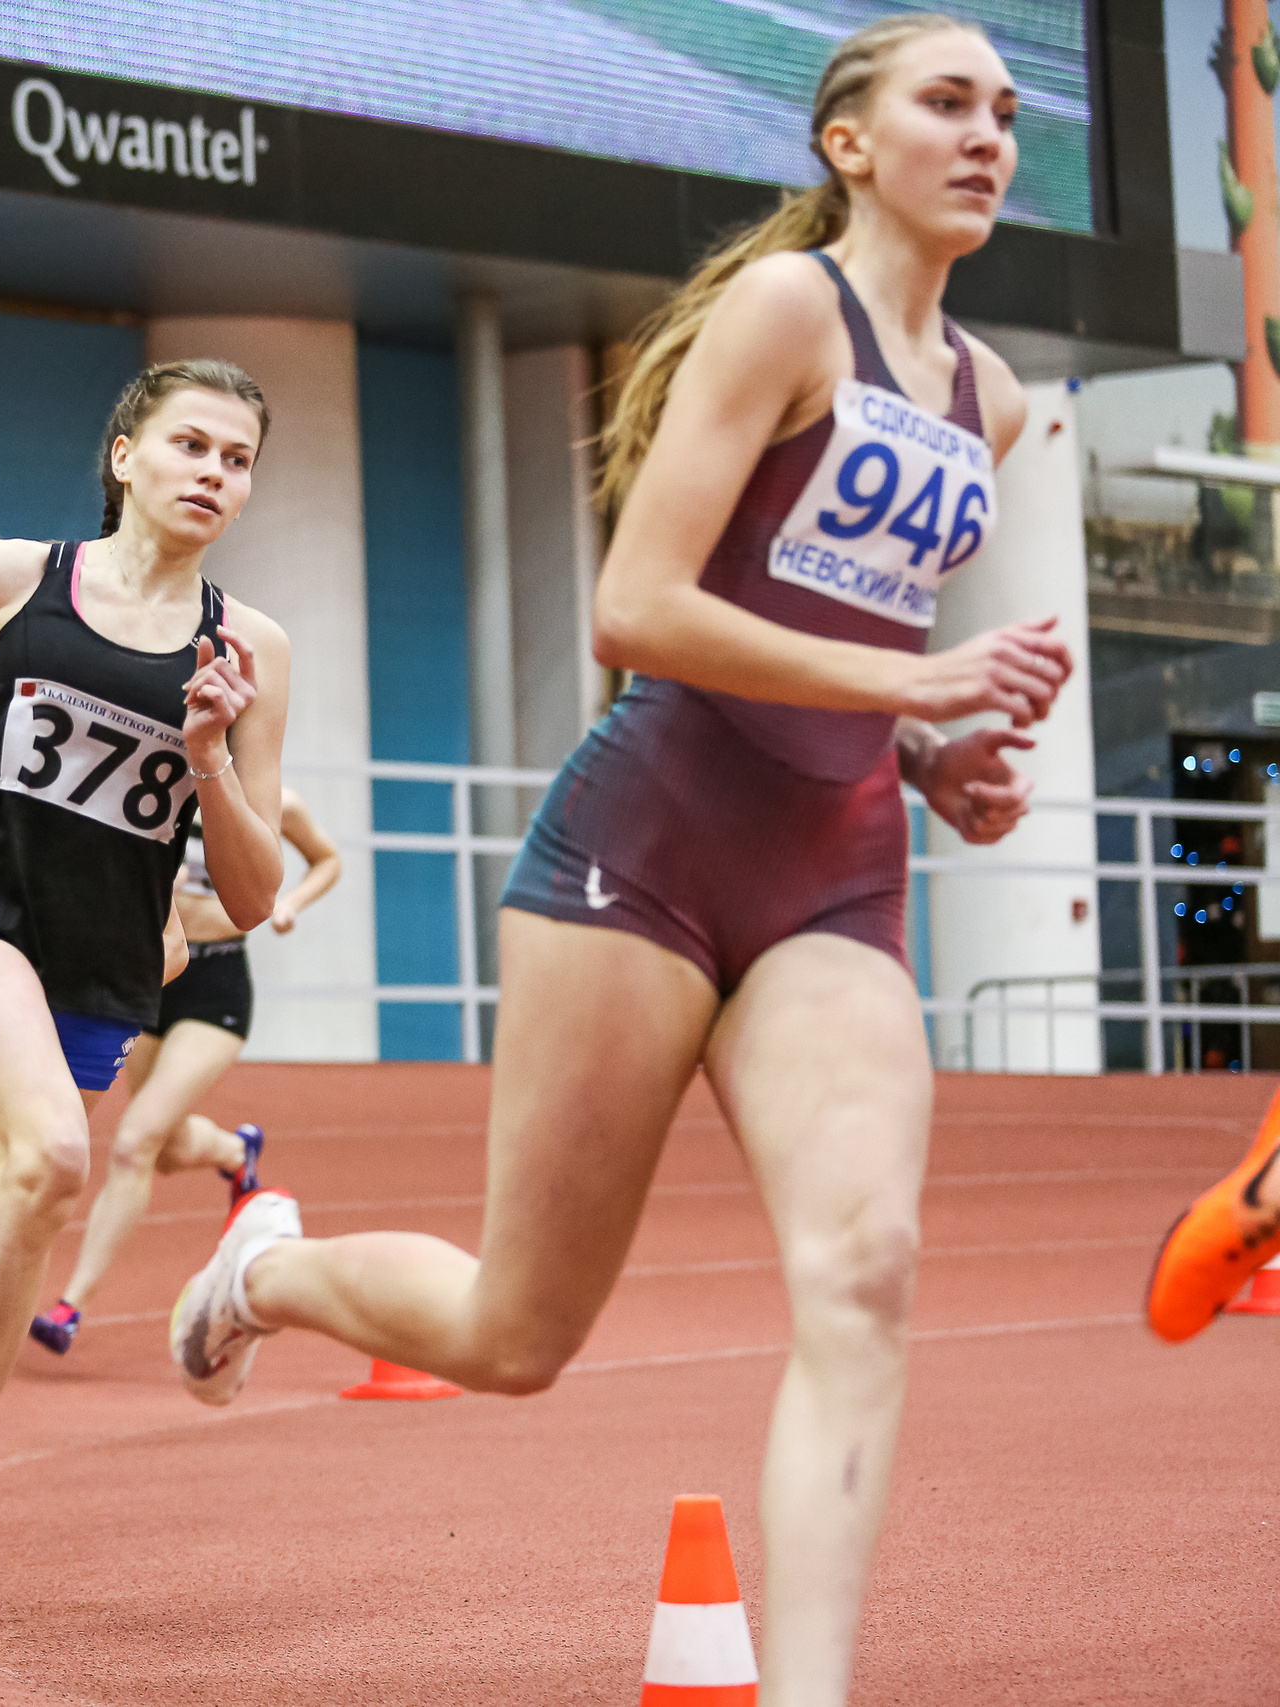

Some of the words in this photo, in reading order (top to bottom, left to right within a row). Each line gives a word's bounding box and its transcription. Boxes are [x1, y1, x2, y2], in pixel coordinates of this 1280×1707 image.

[11, 76, 257, 187] Qwantel
[817, 441, 988, 574] 946
[17, 703, 189, 831] 378
[39, 686, 108, 717] АКАДЕМИЯ
[107, 710, 156, 738] ЛЕГКОЙ
[155, 731, 188, 750] АТЛЕ
